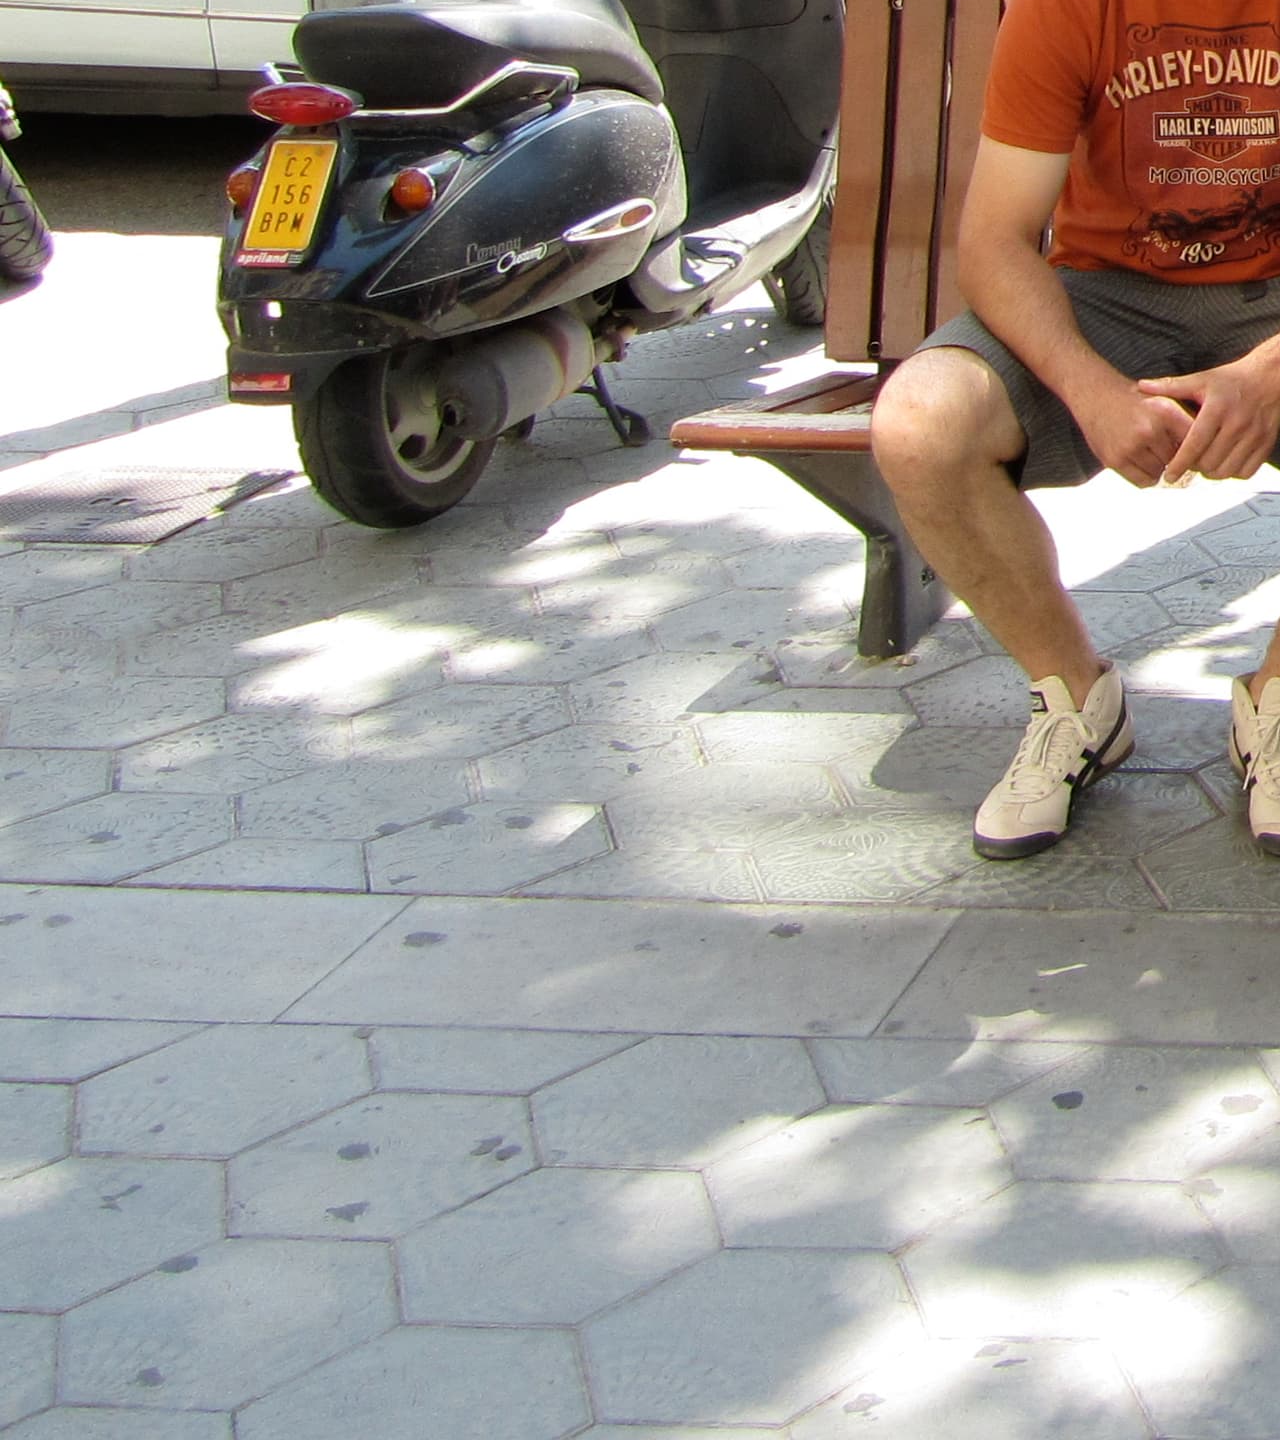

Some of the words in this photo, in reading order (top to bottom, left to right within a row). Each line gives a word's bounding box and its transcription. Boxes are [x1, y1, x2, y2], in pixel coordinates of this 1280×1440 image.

[1184, 34, 1249, 49] GENUINE
[1193, 96, 1242, 112] MOTOR
[1159, 117, 1275, 137] HARLEY-DAVIDSON
[285, 156, 312, 177] C2
[272, 184, 312, 205] 156
[260, 212, 304, 232] BPM
